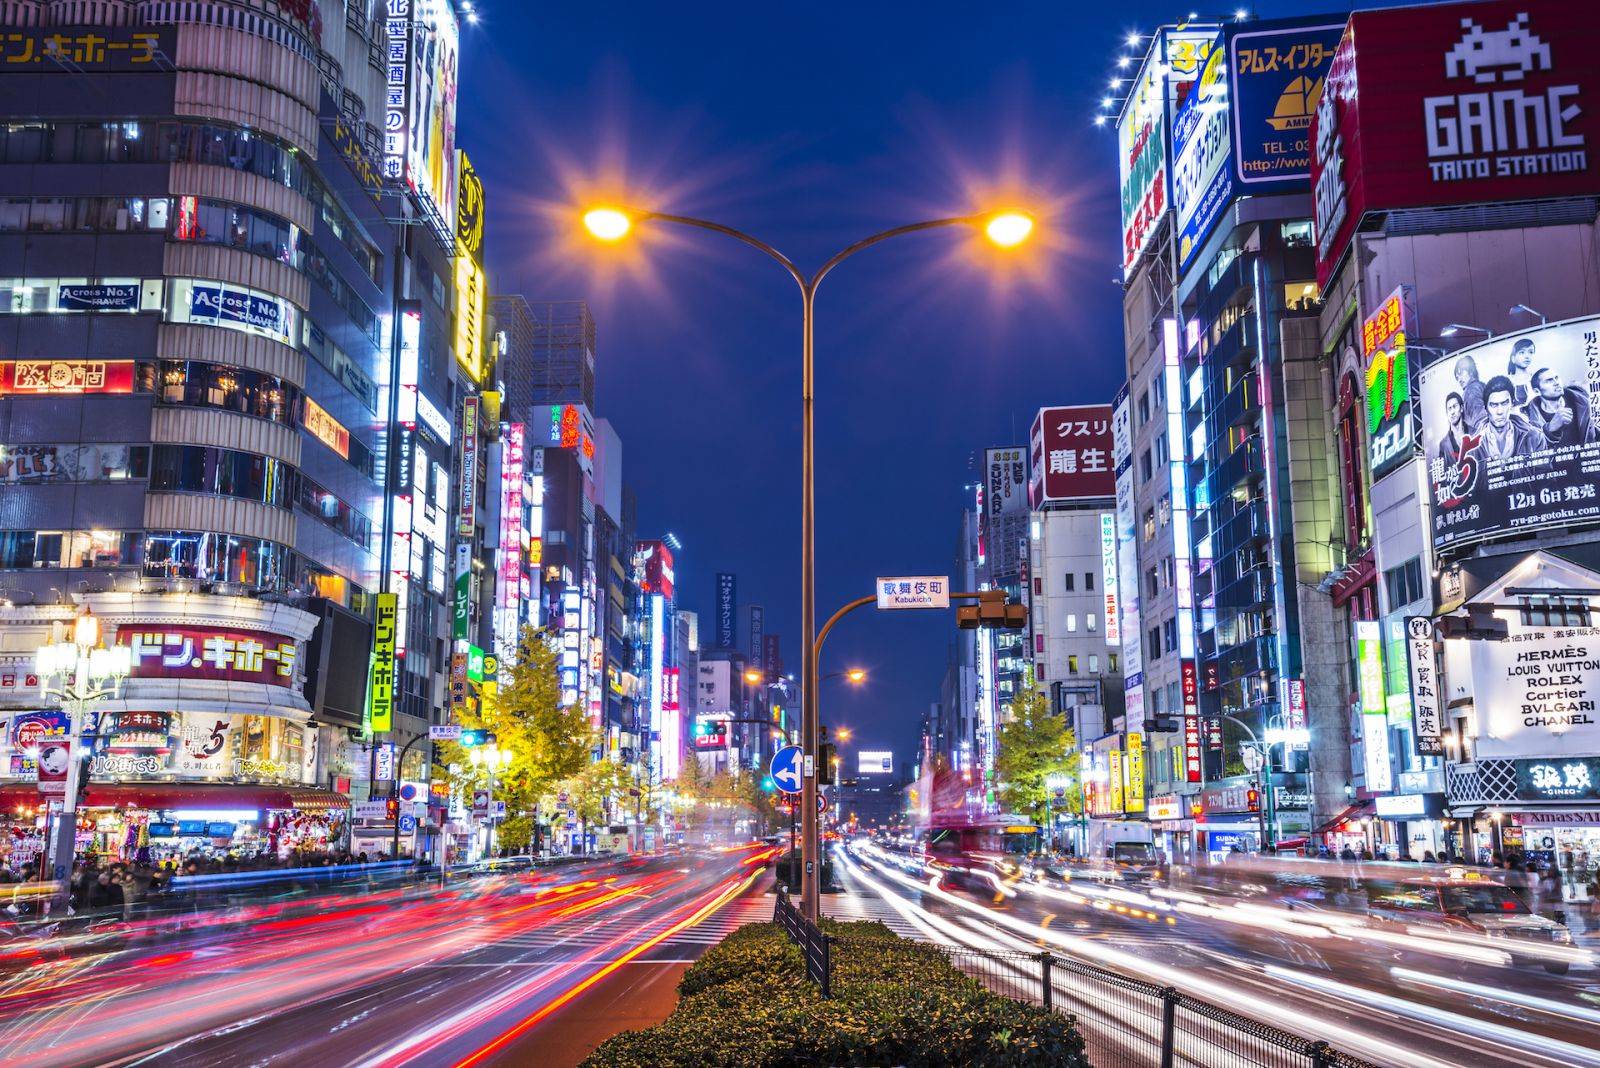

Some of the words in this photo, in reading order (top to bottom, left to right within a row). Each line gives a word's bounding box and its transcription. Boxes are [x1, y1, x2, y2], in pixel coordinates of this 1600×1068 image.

[1423, 84, 1586, 157] GAME
[1429, 158, 1491, 181] TAITO
[1496, 150, 1587, 177] STATION
[883, 581, 942, 595] 歌舞伎町
[456, 590, 467, 618] レイク
[1508, 665, 1540, 676] LOUIS
[1547, 660, 1600, 673] VUITTON
[1527, 675, 1582, 687] ROLEX
[1526, 688, 1586, 701] Cartier
[1521, 700, 1594, 714] BVLGARI
[1524, 714, 1594, 727] CHANEL
